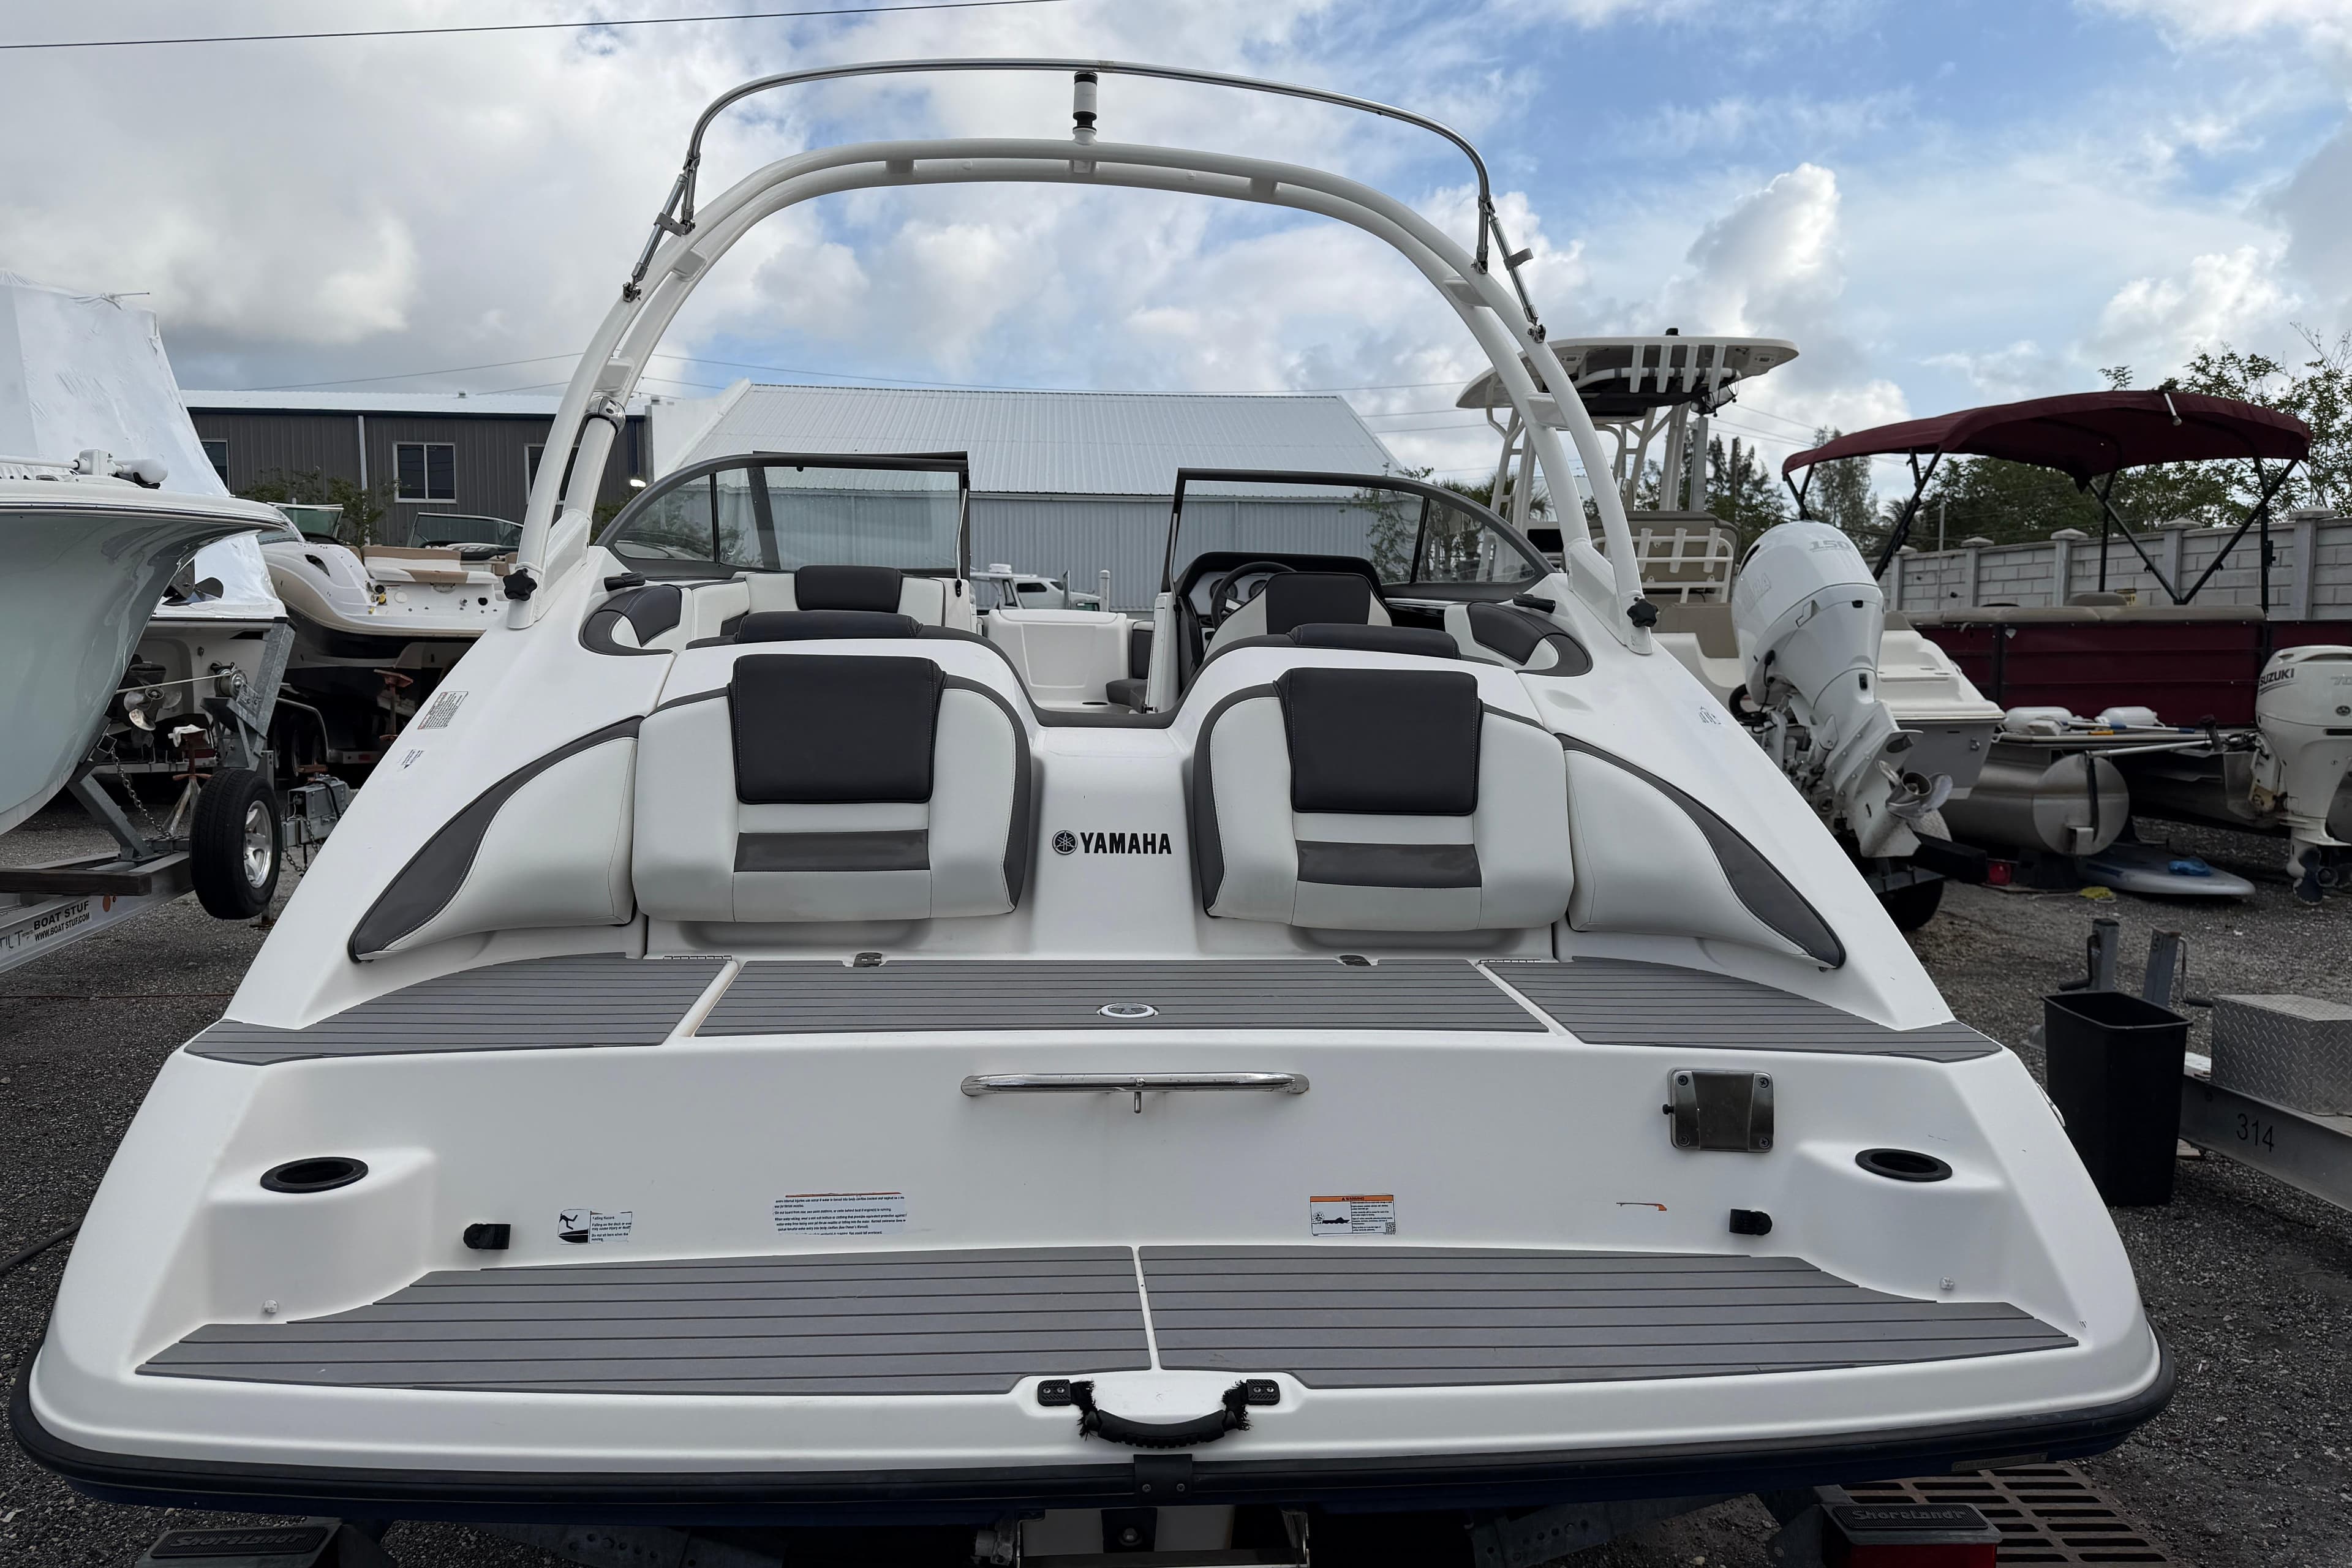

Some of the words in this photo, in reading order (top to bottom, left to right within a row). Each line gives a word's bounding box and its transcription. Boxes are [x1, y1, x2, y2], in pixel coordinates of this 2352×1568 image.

[1809, 540, 1851, 550] 150
[2260, 668, 2295, 687] SUZUKI
[1080, 832, 1172, 854] YAMAHA
[34, 911, 62, 930] BOAT
[64, 900, 89, 918] STUF
[2236, 1112, 2274, 1153] 314
